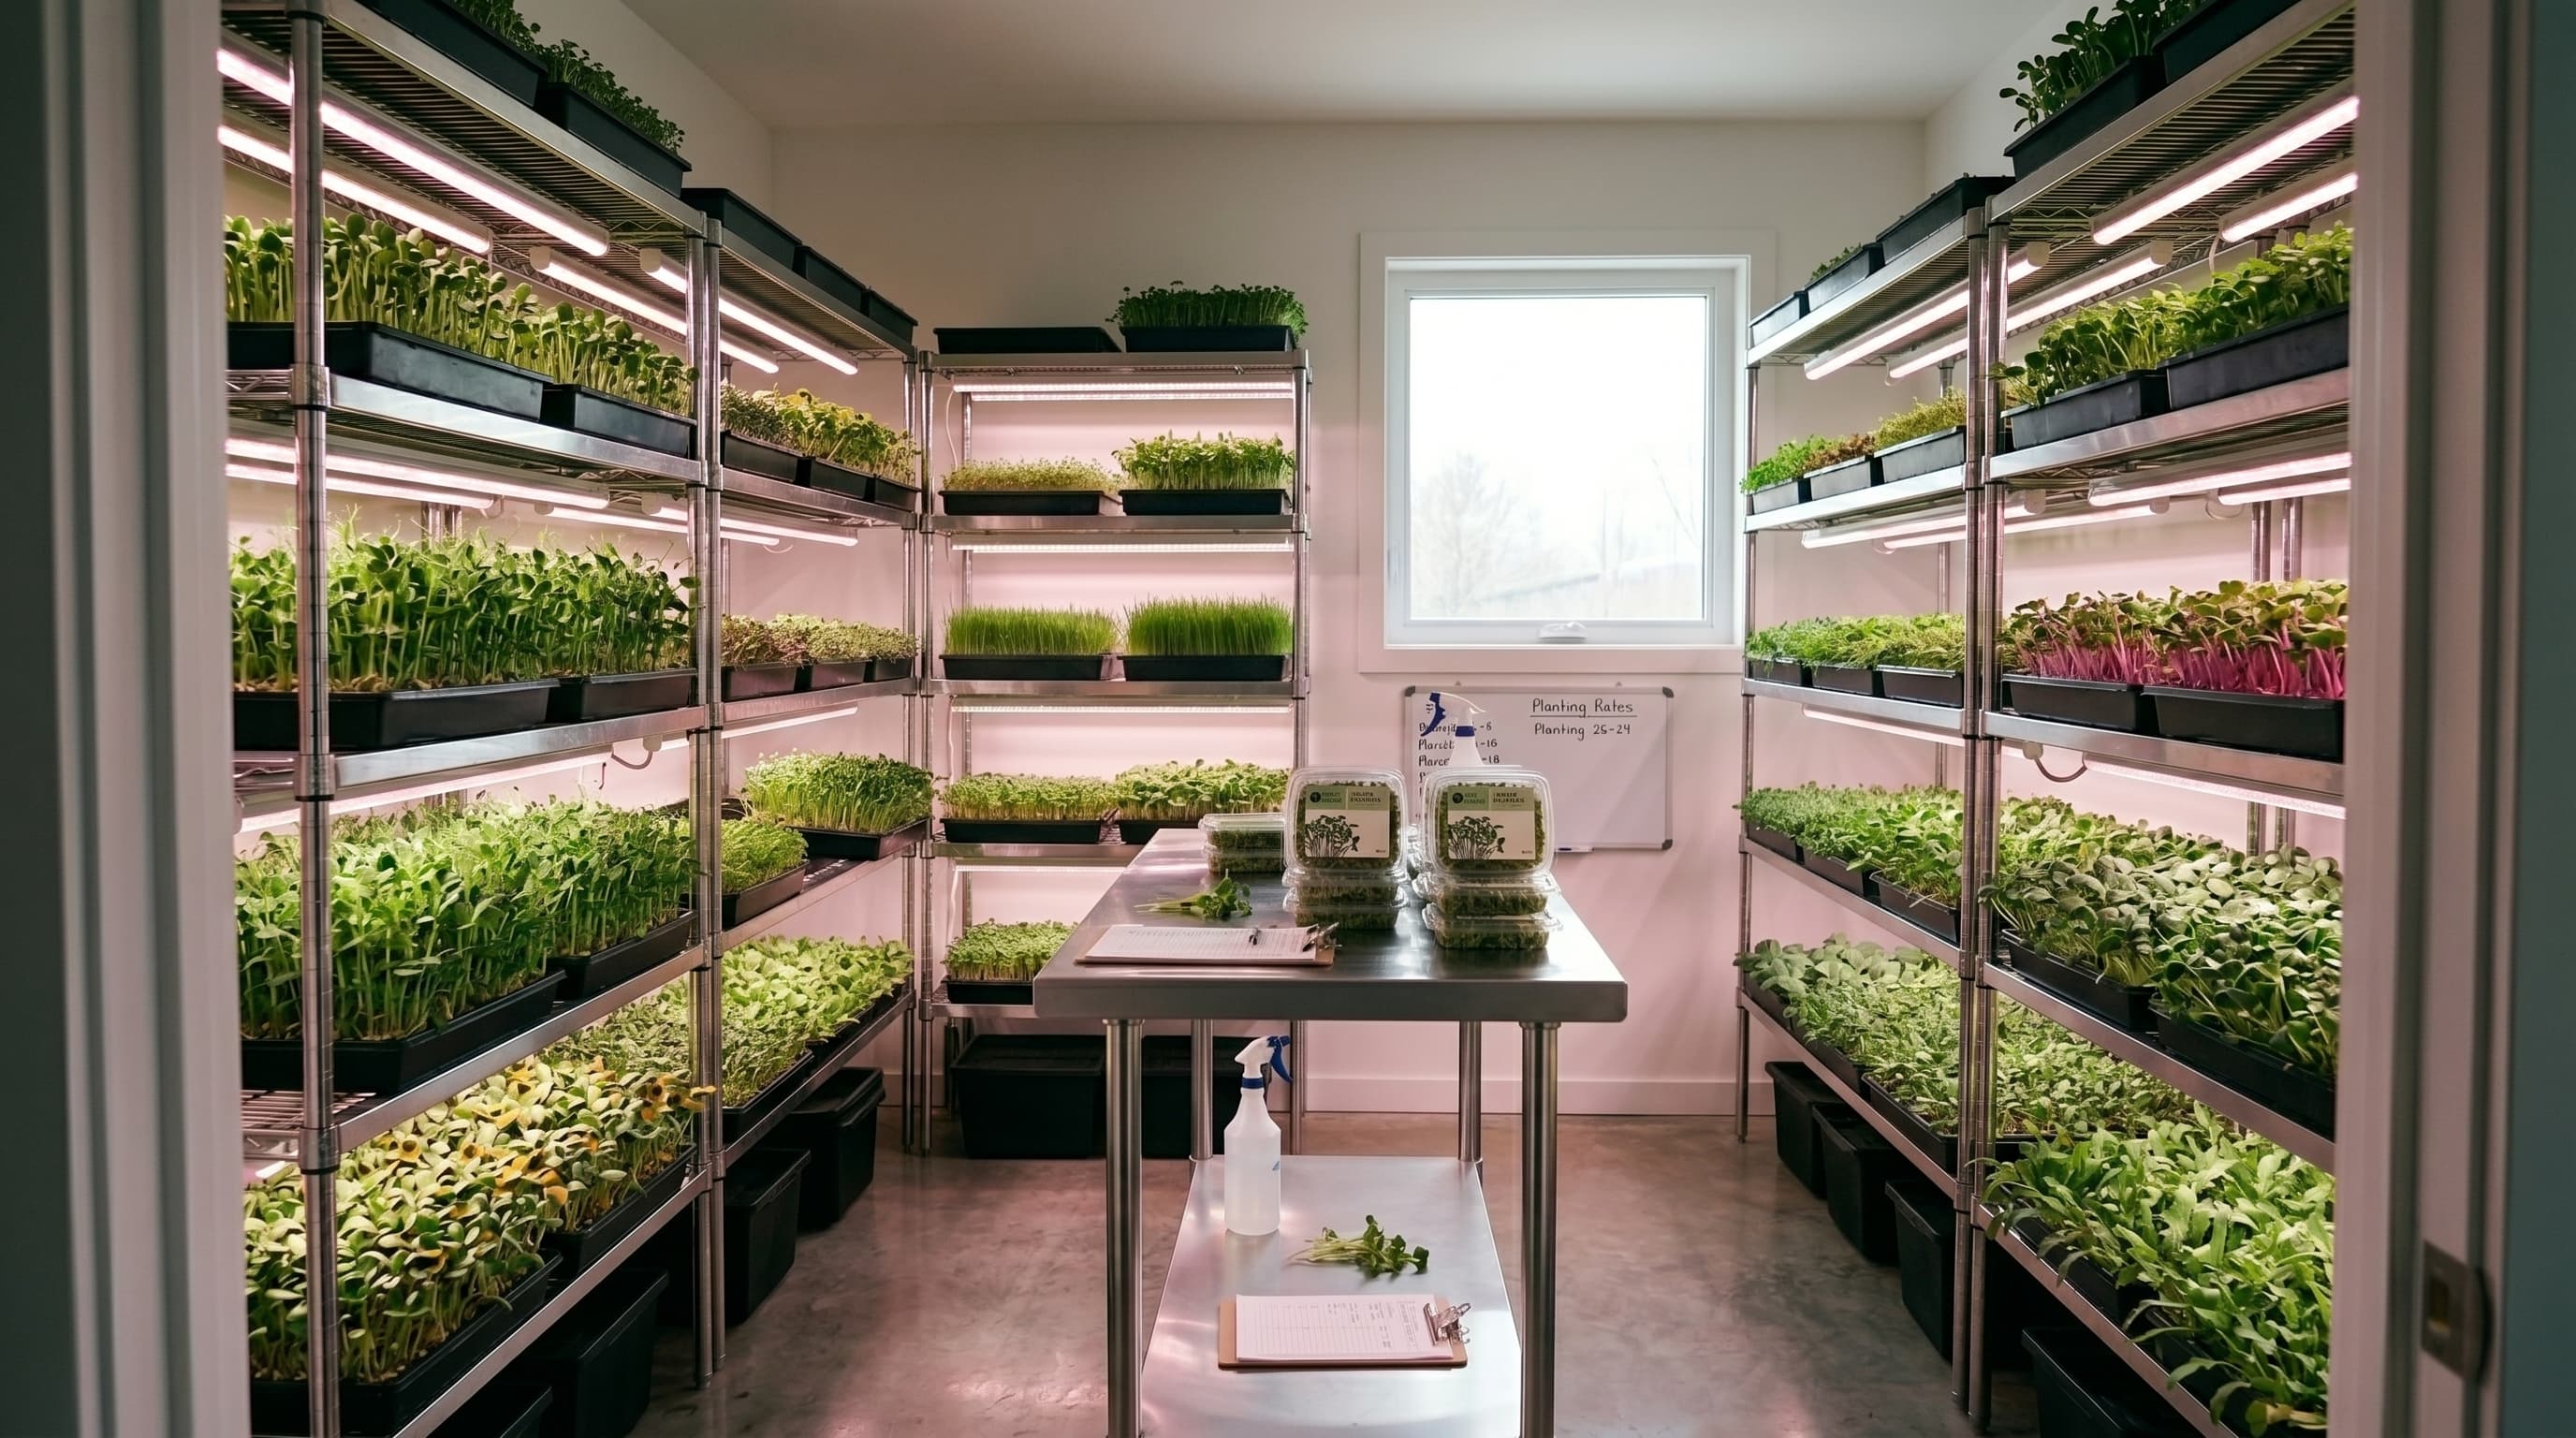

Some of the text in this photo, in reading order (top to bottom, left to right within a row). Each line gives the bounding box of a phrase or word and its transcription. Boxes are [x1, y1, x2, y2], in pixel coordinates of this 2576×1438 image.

[1532, 697, 1633, 718] Planting Rates
[1534, 722, 1585, 741] Planting
